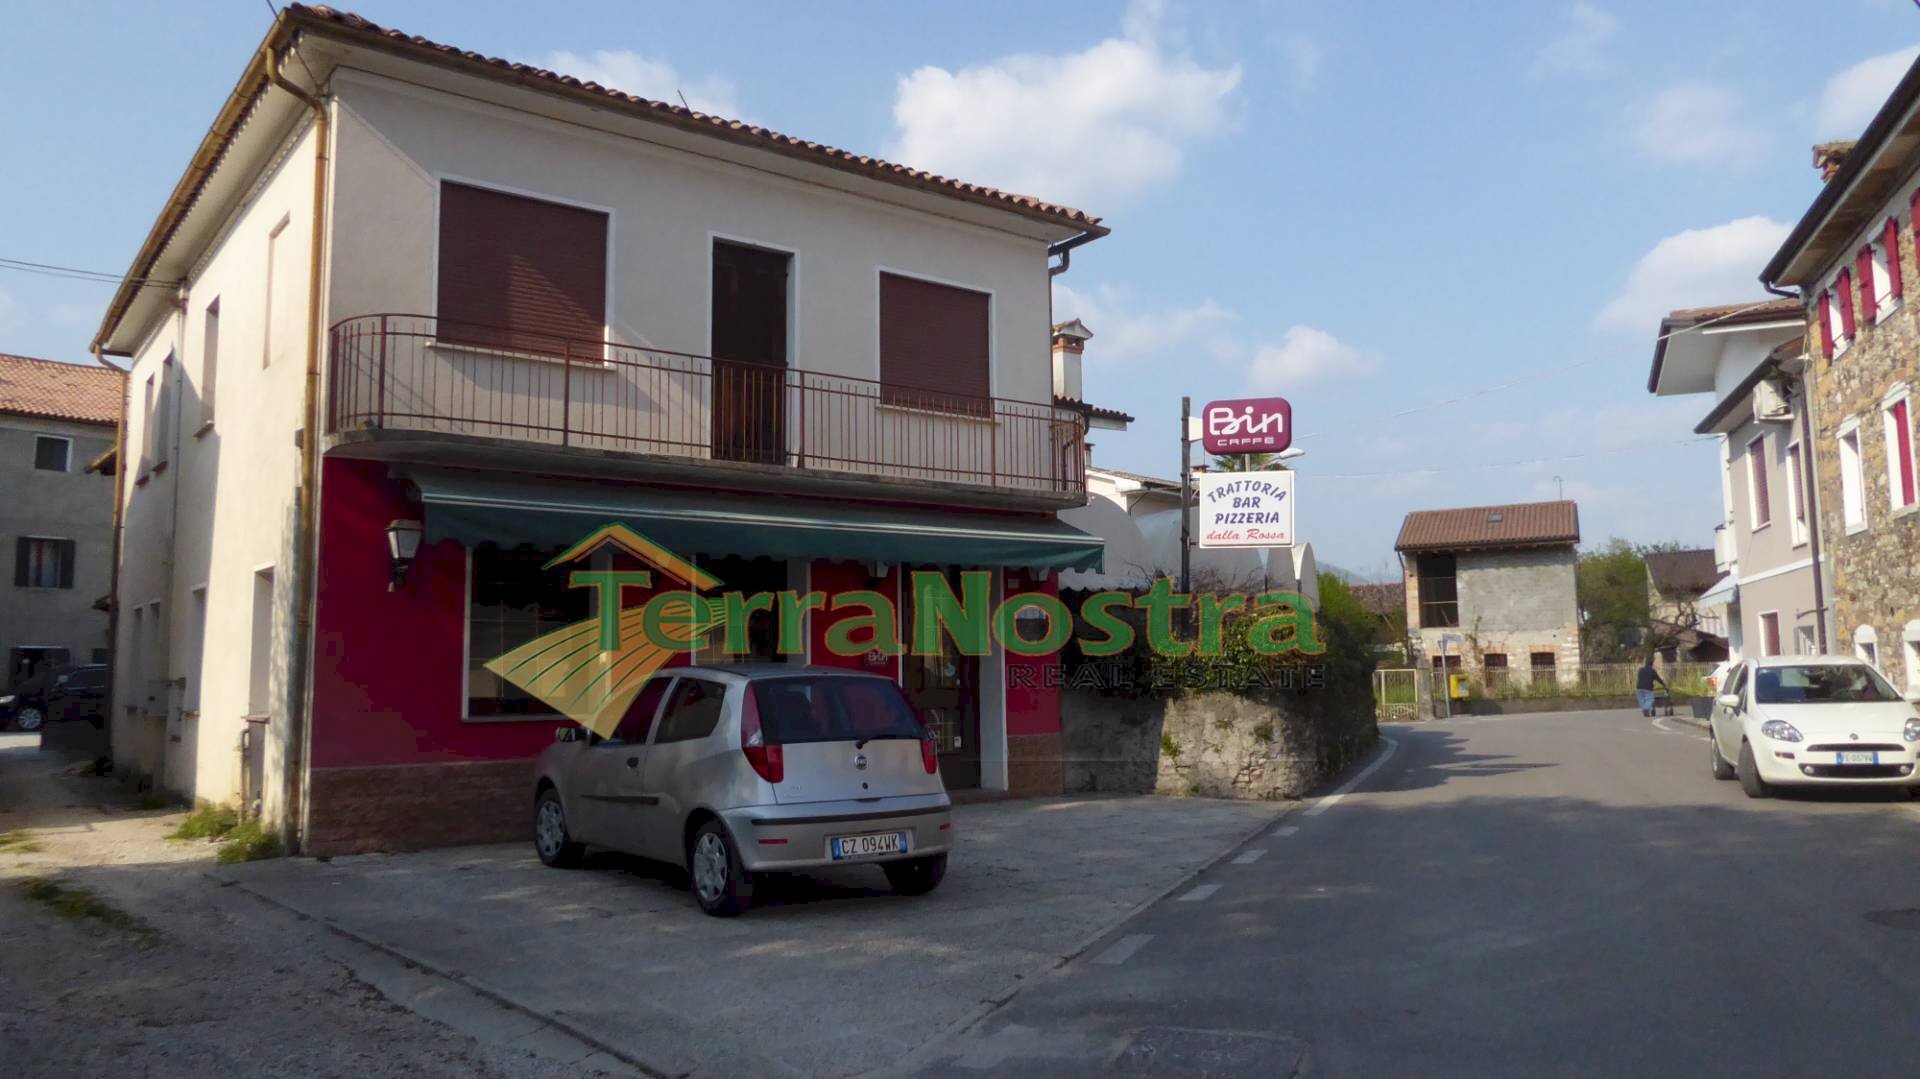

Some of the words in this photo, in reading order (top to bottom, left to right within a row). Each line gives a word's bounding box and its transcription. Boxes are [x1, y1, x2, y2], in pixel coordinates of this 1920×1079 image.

[1209, 406, 1284, 436] Bin
[1207, 480, 1287, 503] TRATTORIA
[1232, 496, 1262, 509] BAR
[1215, 511, 1280, 525] PIZZERIA
[1206, 530, 1241, 541] dalla
[1246, 528, 1285, 540] Rossa
[841, 838, 858, 855] CZ
